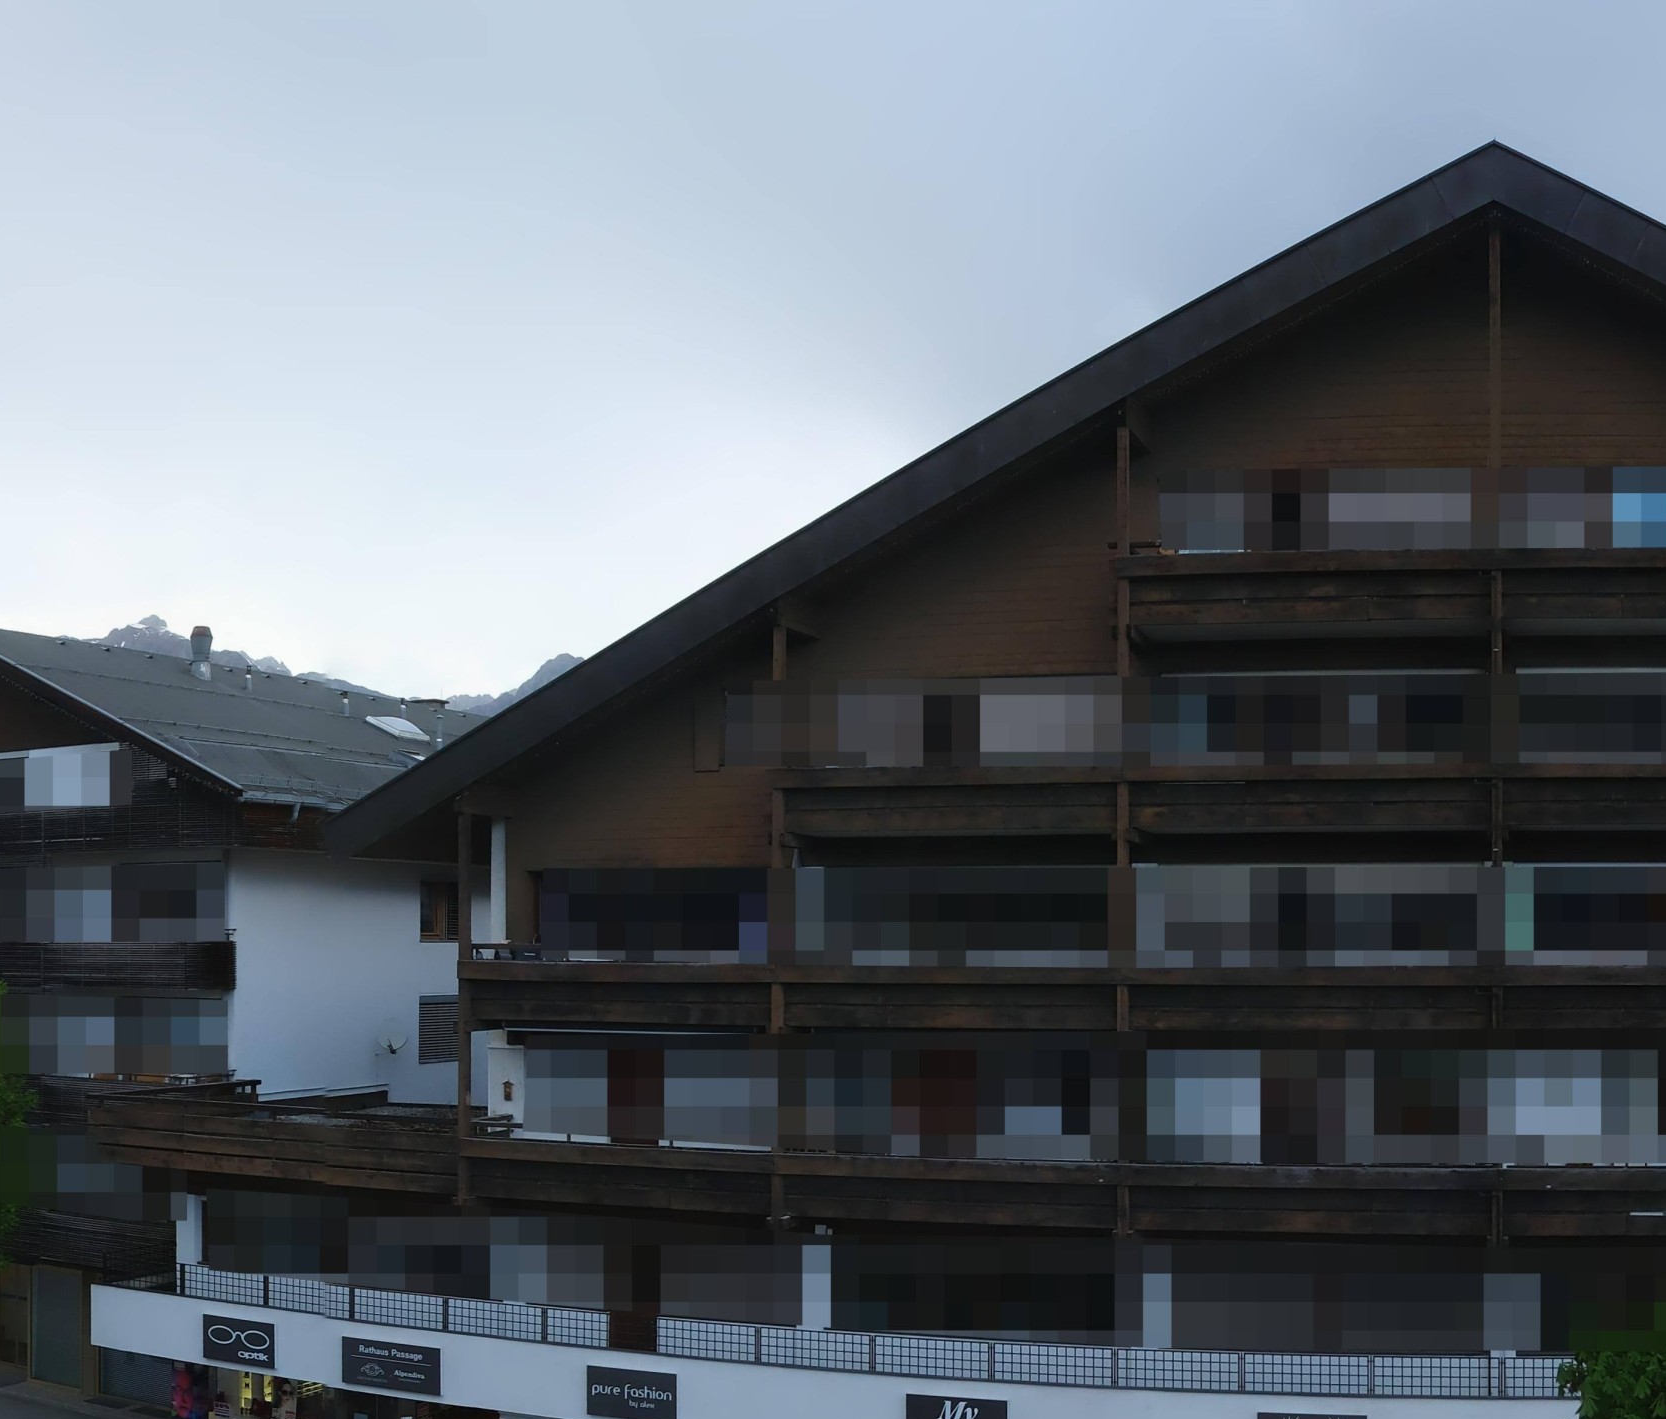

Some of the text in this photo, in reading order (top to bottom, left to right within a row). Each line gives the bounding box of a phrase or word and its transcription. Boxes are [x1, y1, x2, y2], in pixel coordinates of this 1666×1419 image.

[237, 1350, 269, 1361] optik
[358, 1344, 423, 1361] Rathaus Passage
[592, 1384, 672, 1401] pure fashion
[629, 1400, 638, 1408] by
